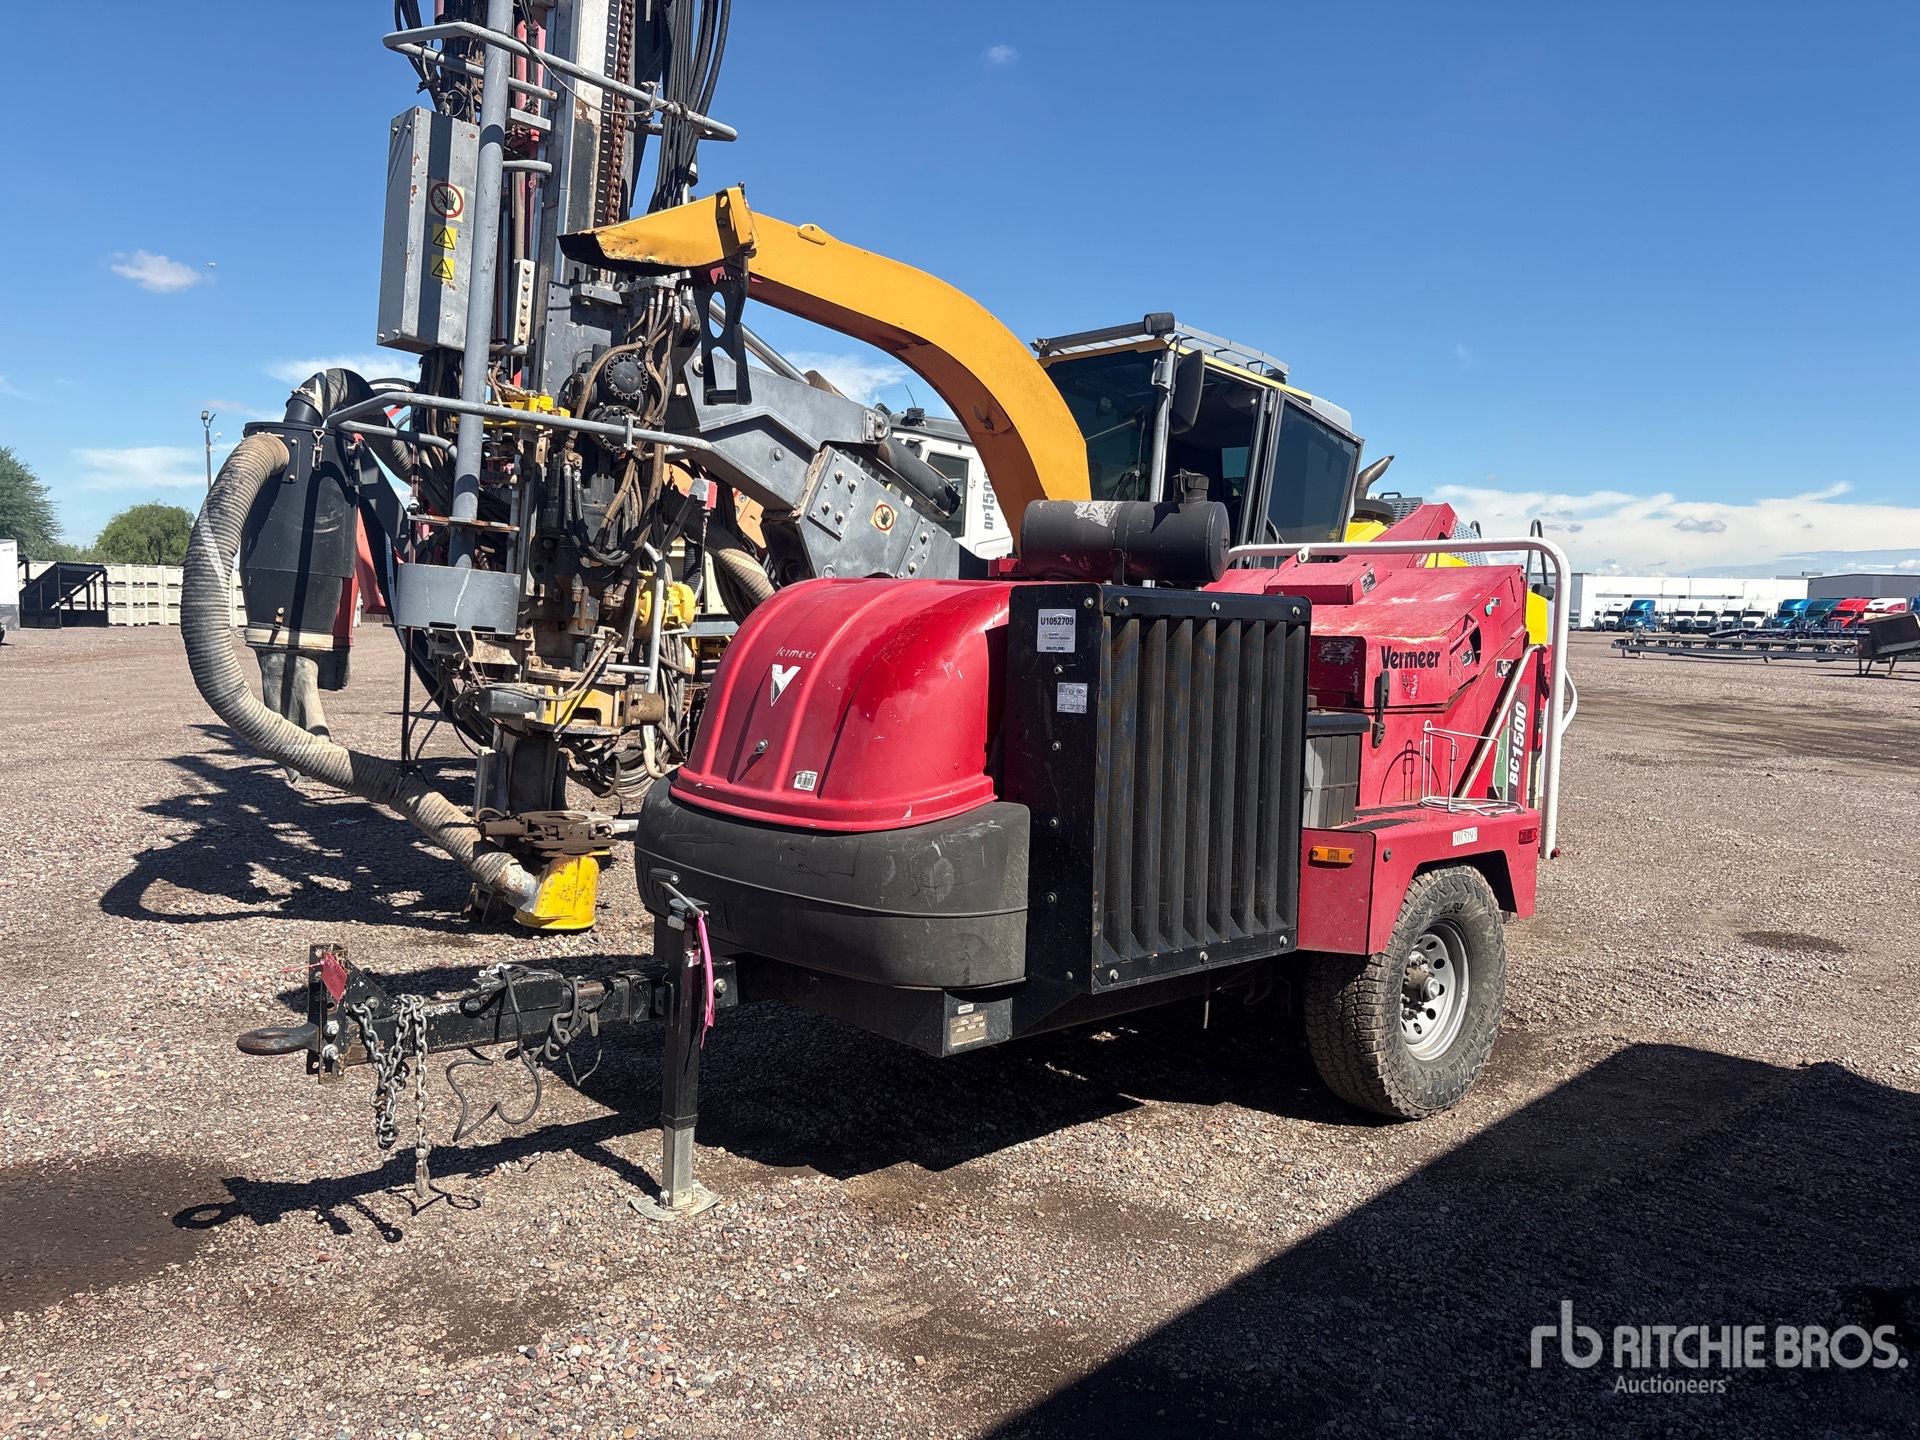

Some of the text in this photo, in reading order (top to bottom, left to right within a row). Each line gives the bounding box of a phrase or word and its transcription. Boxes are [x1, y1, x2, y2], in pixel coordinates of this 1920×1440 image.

[1041, 617, 1074, 626] U1052709
[1381, 645, 1440, 669] Vermeer
[1509, 701, 1527, 786] BC1500
